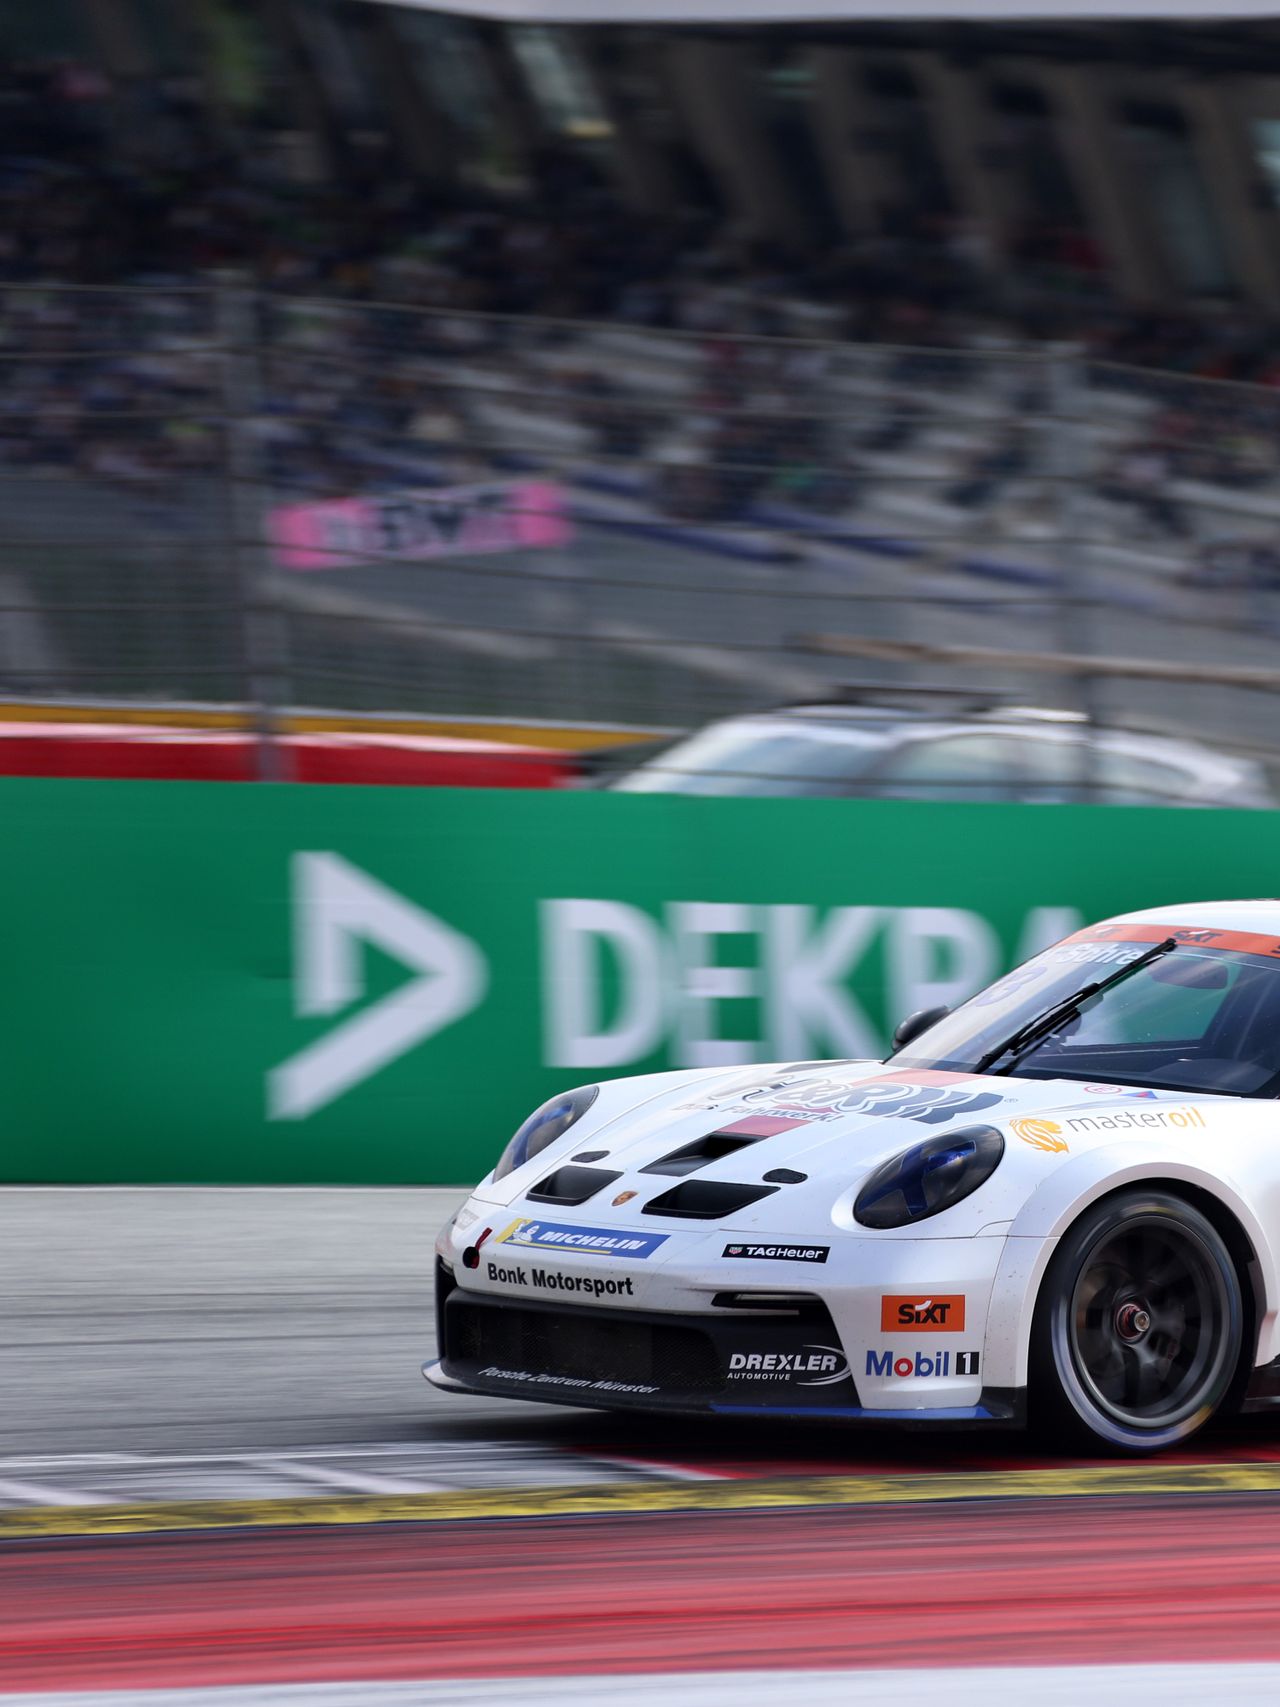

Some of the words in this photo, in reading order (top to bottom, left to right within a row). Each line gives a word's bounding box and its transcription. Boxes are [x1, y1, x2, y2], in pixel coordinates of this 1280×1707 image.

[1065, 1105, 1207, 1133] masteroil
[537, 1230, 649, 1251] MICHELIN
[487, 1262, 528, 1286] Bonk
[532, 1268, 635, 1298] Motorsport
[728, 1353, 838, 1372] DREXLER
[865, 1350, 950, 1377] Mobil
[477, 1366, 532, 1381] Porsche
[528, 1373, 592, 1388] Zentrum
[588, 1380, 661, 1394] Münster
[726, 1372, 791, 1381] AUTOMOTIVE
